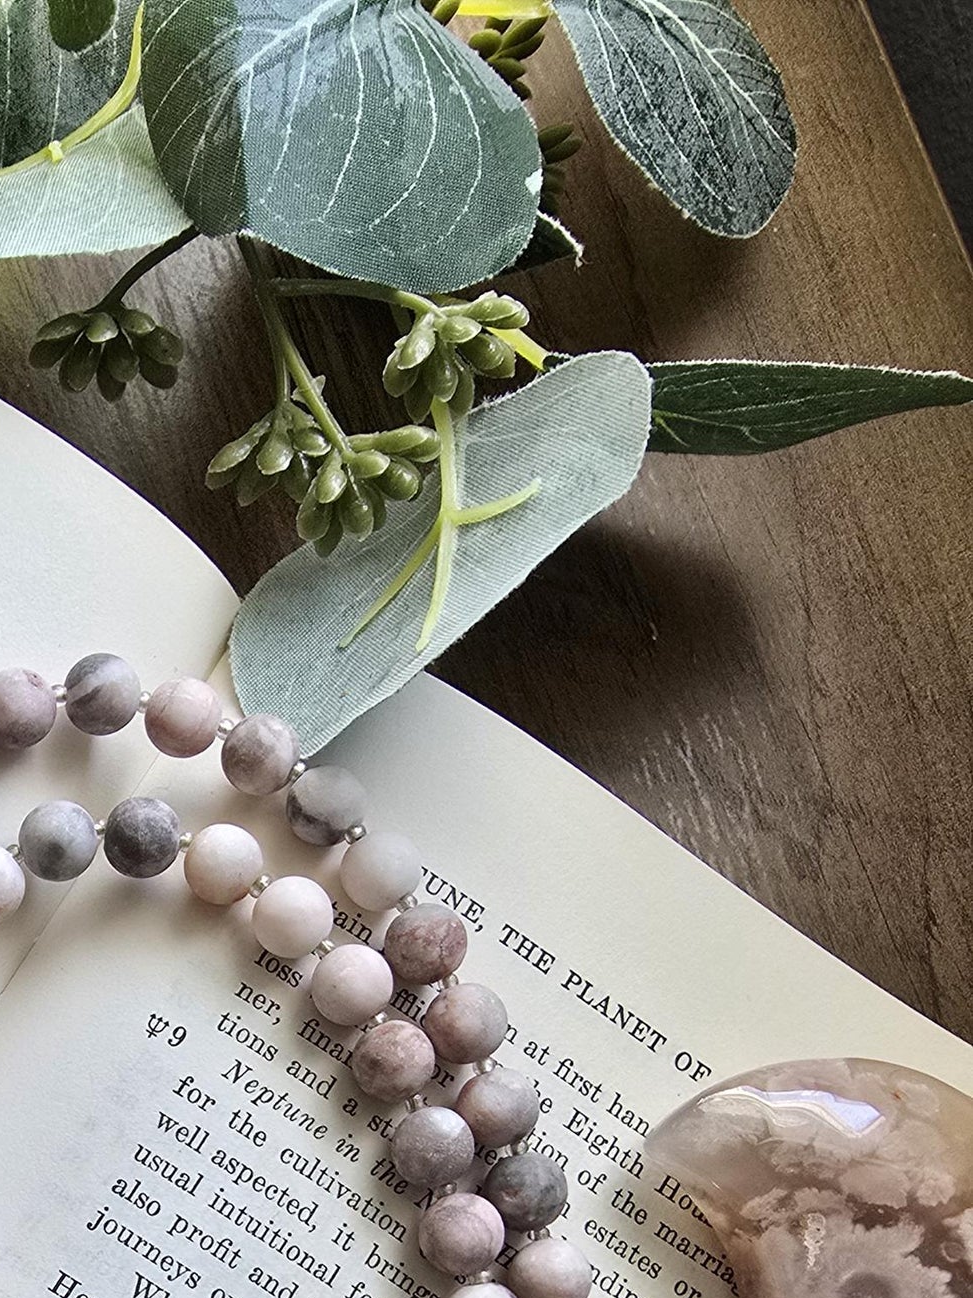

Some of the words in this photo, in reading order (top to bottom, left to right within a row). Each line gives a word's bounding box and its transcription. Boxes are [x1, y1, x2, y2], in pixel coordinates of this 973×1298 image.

[498, 923, 556, 976] THE
[560, 968, 668, 1054] PLANET
[674, 1051, 713, 1083] OF
[216, 1011, 279, 1062] tions
[285, 1060, 338, 1101] and
[220, 1058, 329, 1140] Neptune
[551, 1058, 604, 1105] first
[157, 1110, 210, 1154] well
[212, 1146, 319, 1233] aspected,
[171, 1075, 217, 1113] for
[228, 1109, 267, 1148] the
[279, 1147, 407, 1245] cultivation
[233, 981, 281, 1026] ner,
[583, 1219, 663, 1280] estates
[562, 1106, 644, 1180] Eighth
[86, 1209, 202, 1290] journeys
[111, 1178, 162, 1217] also
[165, 1213, 242, 1270] profit
[133, 1143, 205, 1198] usual
[207, 1191, 342, 1289] intuitional
[610, 1188, 648, 1226] the
